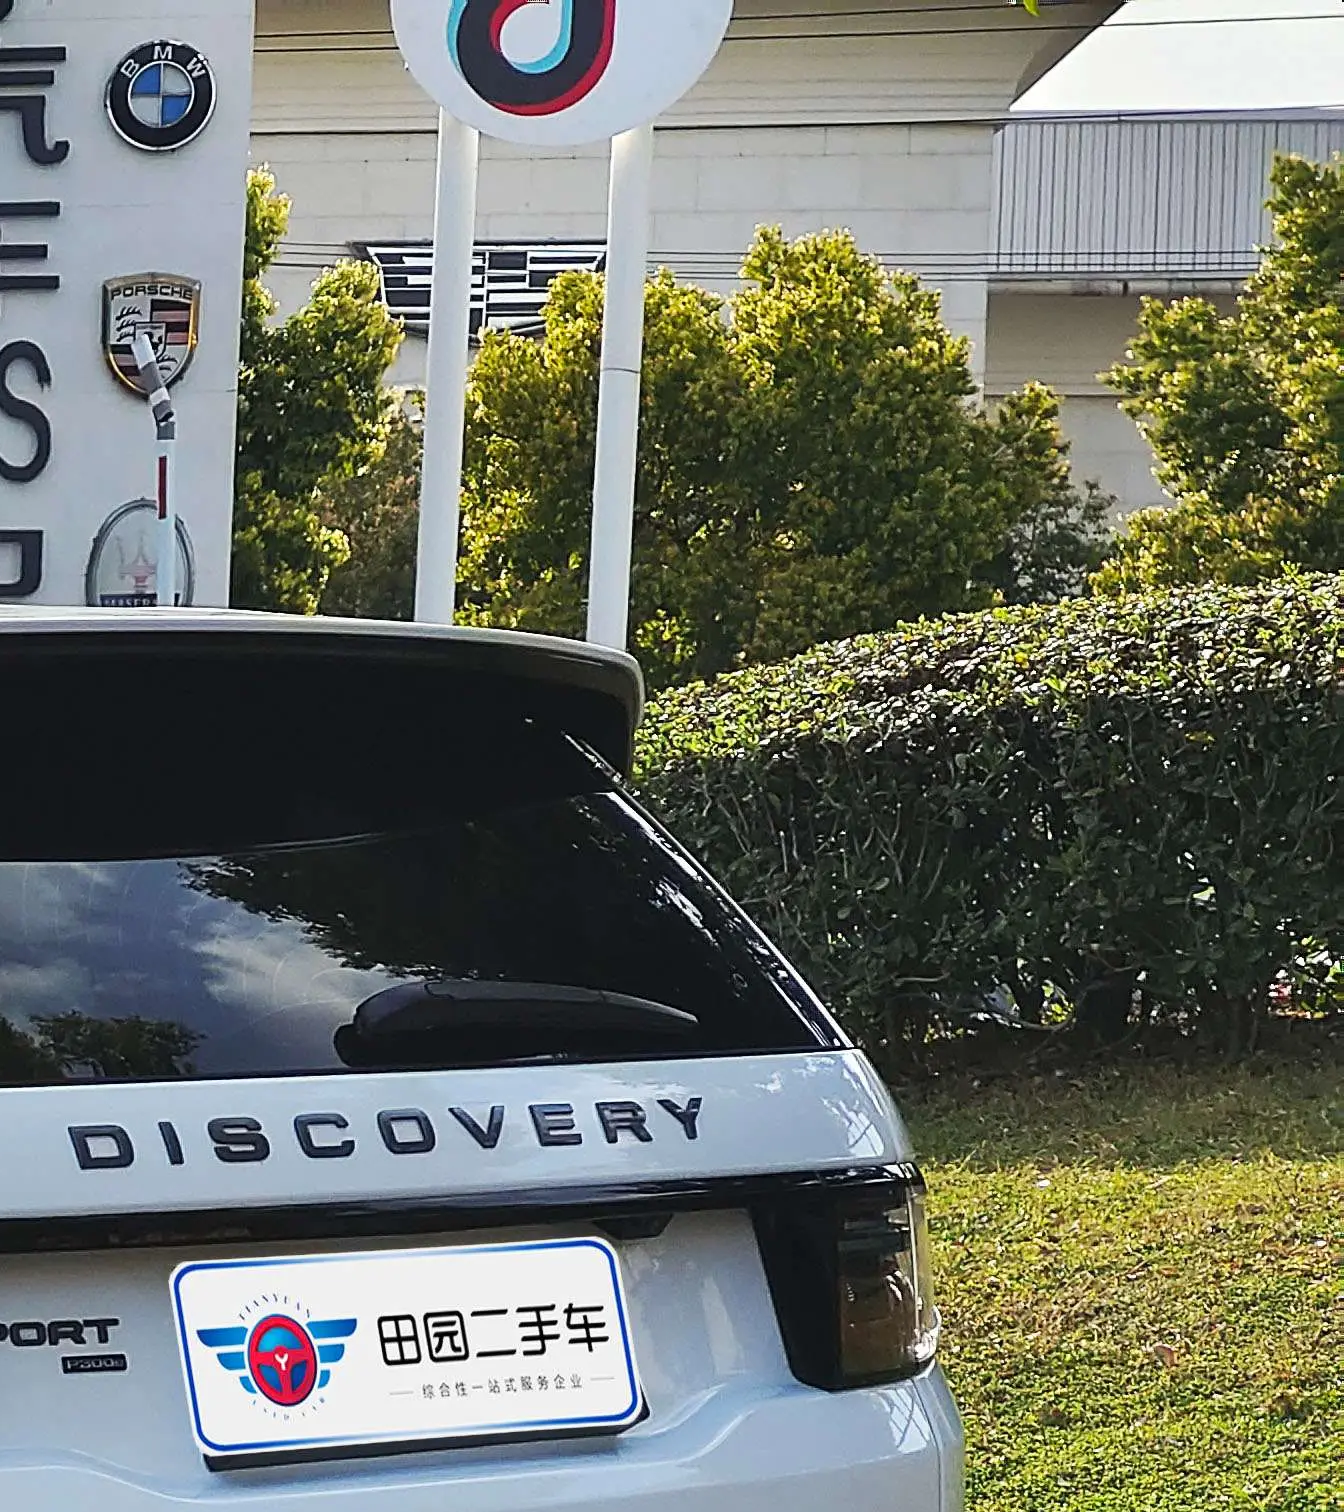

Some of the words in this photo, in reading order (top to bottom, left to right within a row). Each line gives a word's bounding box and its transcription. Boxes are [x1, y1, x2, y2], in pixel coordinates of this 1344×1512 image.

[120, 45, 207, 79] BMW
[111, 284, 195, 301] PORSCHE
[67, 1097, 704, 1171] DISCOVERY
[377, 1303, 610, 1366] 田园二手车
[422, 1373, 583, 1400] 综合性一站式服务企业
